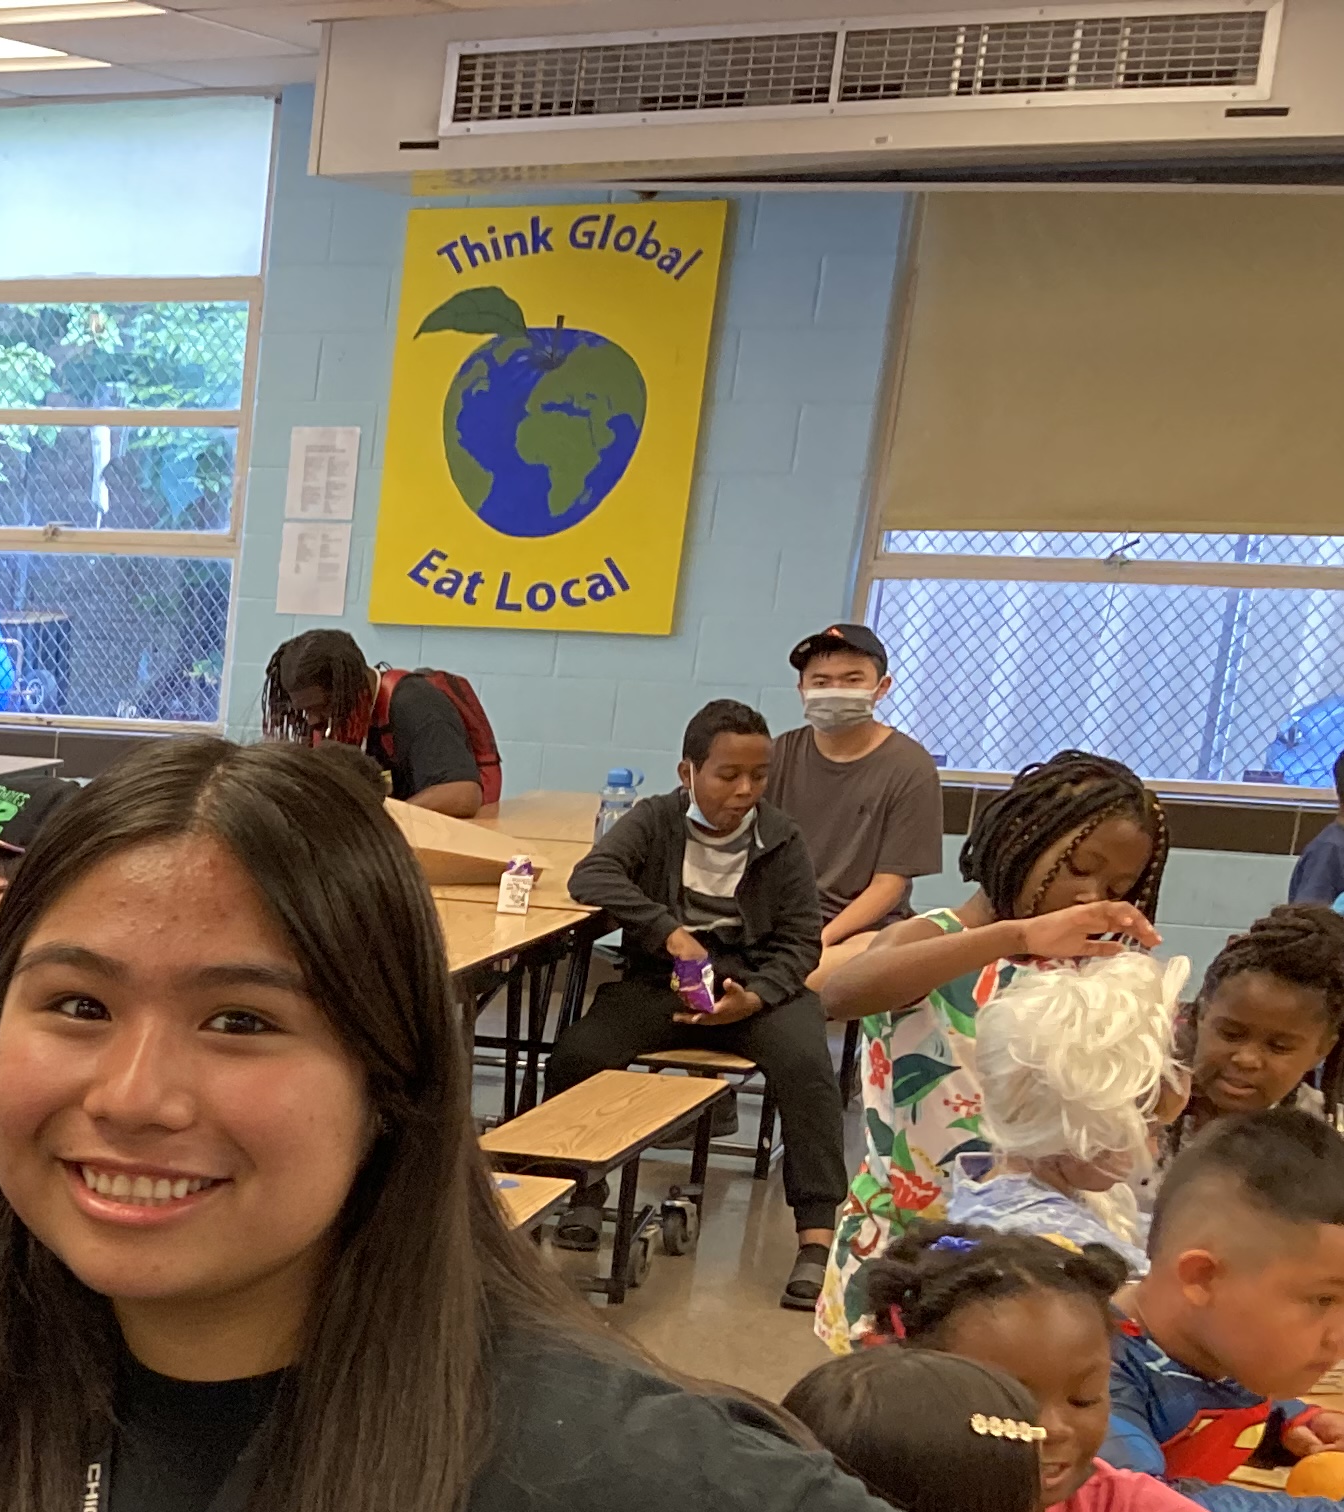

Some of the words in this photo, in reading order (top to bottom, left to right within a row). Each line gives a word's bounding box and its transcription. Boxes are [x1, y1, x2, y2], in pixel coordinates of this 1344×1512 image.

[437, 215, 553, 275] Think
[569, 213, 703, 281] Global
[406, 547, 485, 606] Eat
[495, 557, 630, 613] Local
